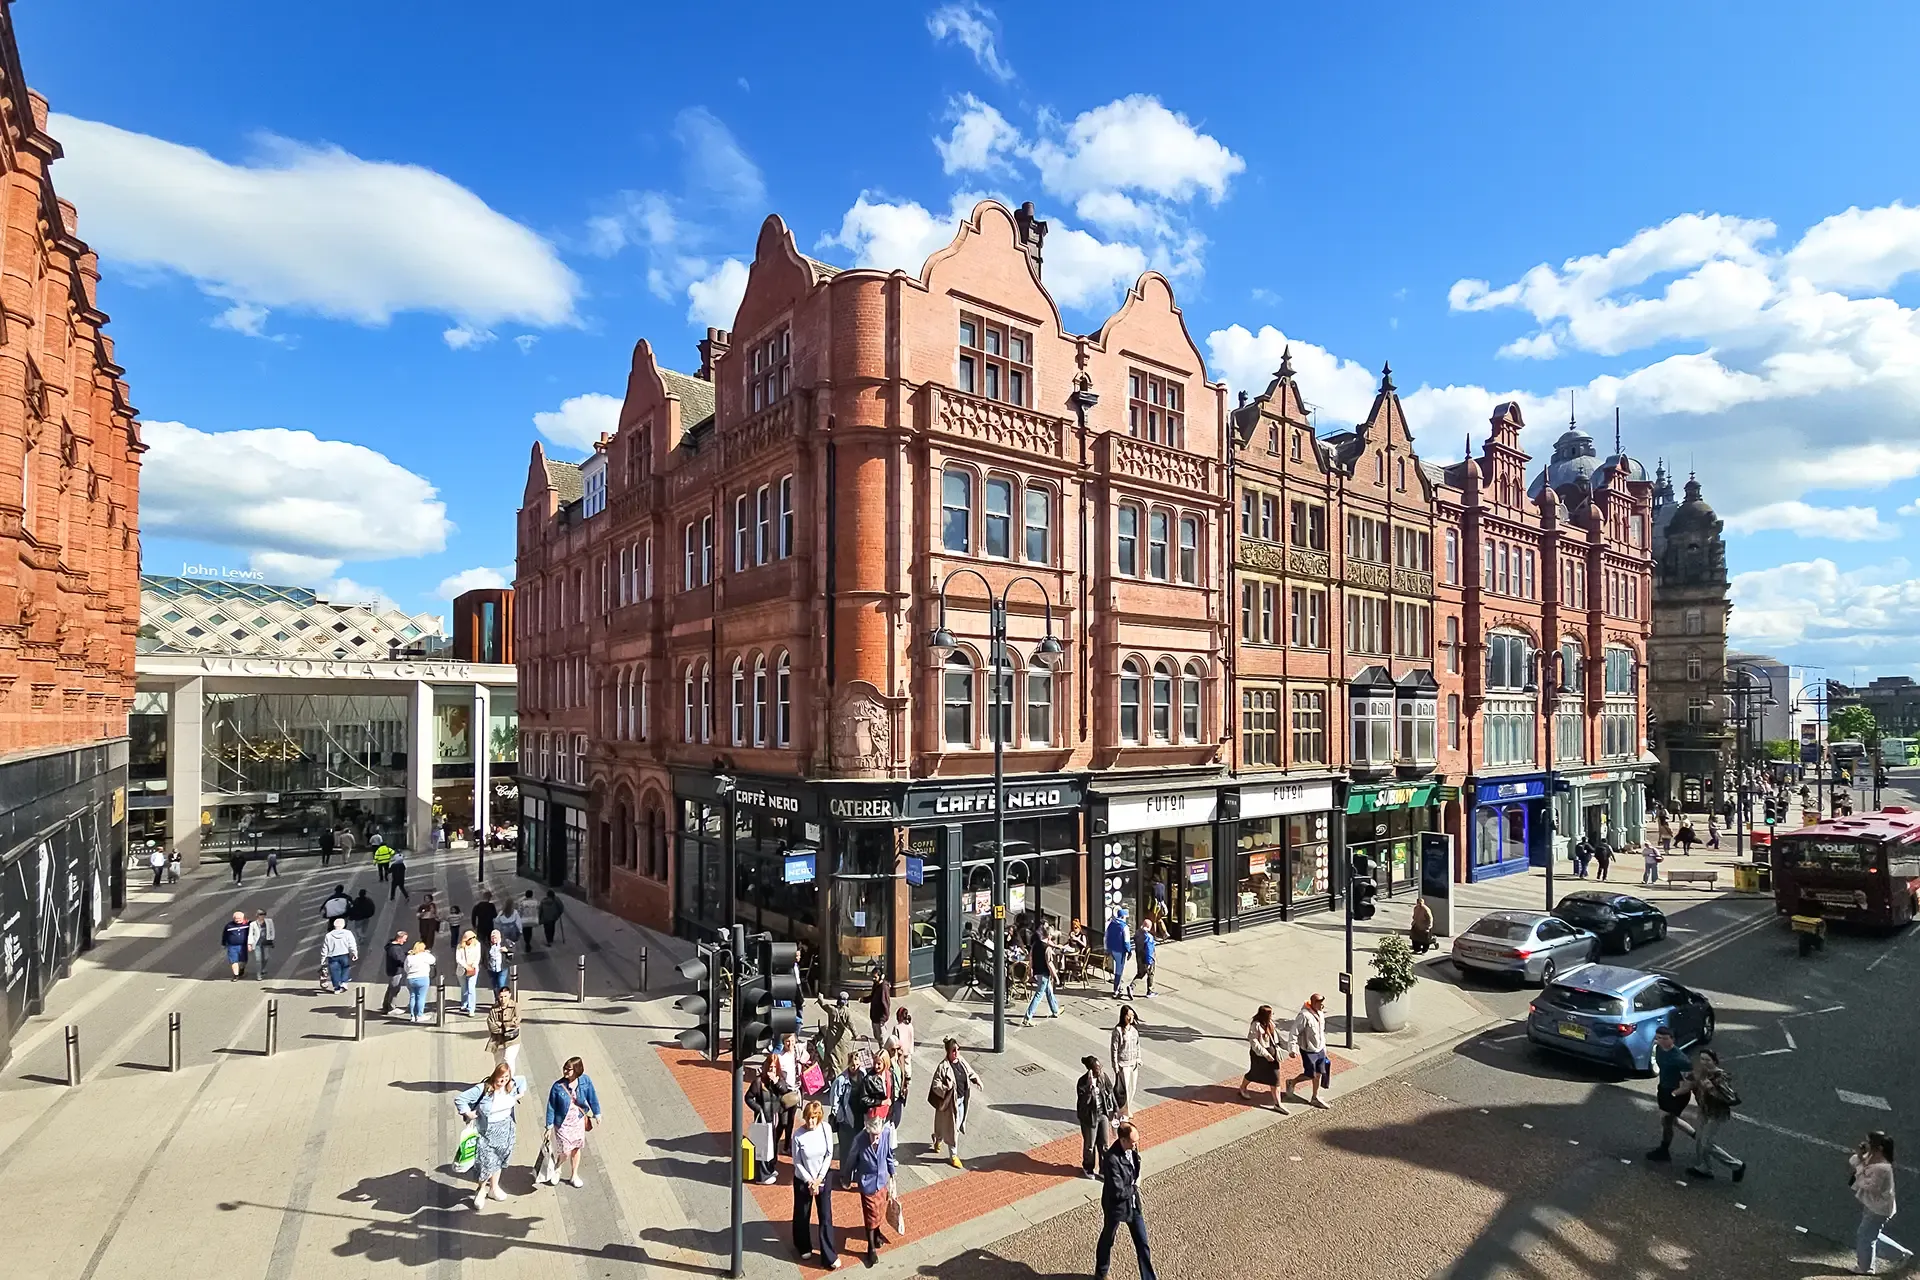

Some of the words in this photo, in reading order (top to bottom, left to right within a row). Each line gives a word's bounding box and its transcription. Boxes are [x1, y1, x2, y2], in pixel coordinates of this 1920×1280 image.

[181, 561, 218, 577] John
[222, 565, 264, 581] Lewis
[200, 657, 376, 679] VICTORIA
[393, 661, 470, 680] GATE
[495, 785, 519, 799] Caff
[735, 789, 767, 807] CAFFÈ
[768, 795, 799, 813] NERO
[935, 788, 997, 814] CAFFÈ
[1008, 789, 1060, 809] NERO
[1273, 784, 1303, 801] FUTON
[1373, 787, 1418, 808] SUBWAY
[829, 799, 892, 817] CATERER
[1146, 794, 1185, 813] FUTON
